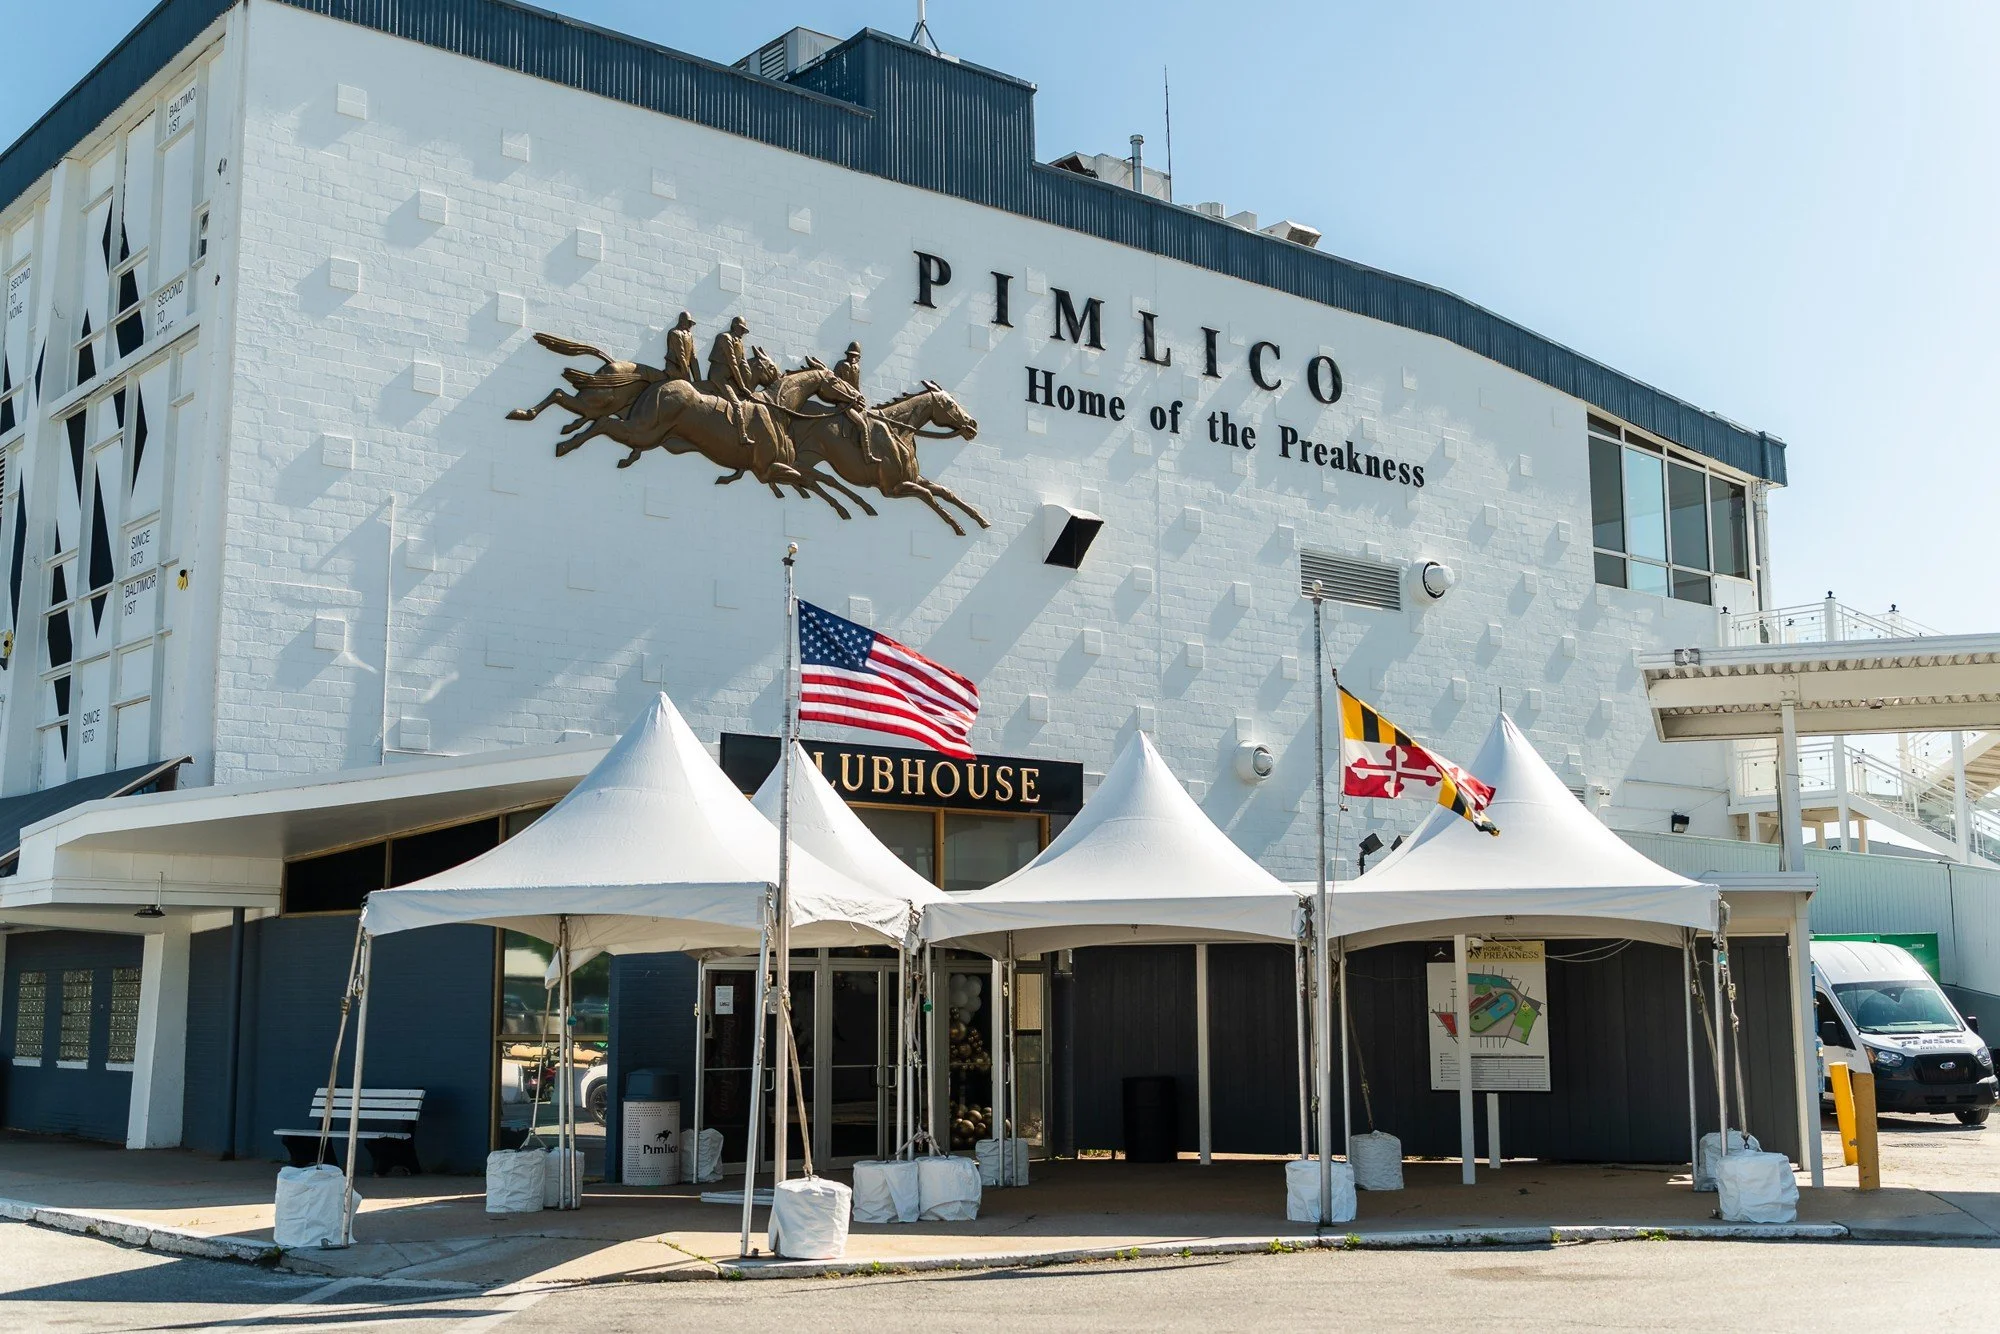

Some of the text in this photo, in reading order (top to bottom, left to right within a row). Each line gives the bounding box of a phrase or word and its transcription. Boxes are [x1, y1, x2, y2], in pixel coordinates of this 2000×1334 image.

[11, 267, 31, 291] SECOND
[10, 292, 17, 306] TO
[157, 280, 184, 308] SECOND
[9, 301, 23, 321] NONE
[157, 309, 166, 325] TO
[914, 250, 1343, 404] PIMLICO
[1025, 365, 1425, 488] Home of the Preakness
[130, 529, 151, 550] SINCE
[130, 550, 144, 568] 1873
[125, 574, 157, 598] BALTIMOR
[82, 708, 101, 726] SINCE
[82, 728, 95, 744] 1873
[813, 751, 1041, 803] LUBHOUSE
[1483, 951, 1540, 960] PREAKNESS
[643, 1144, 679, 1155] Pimlico
